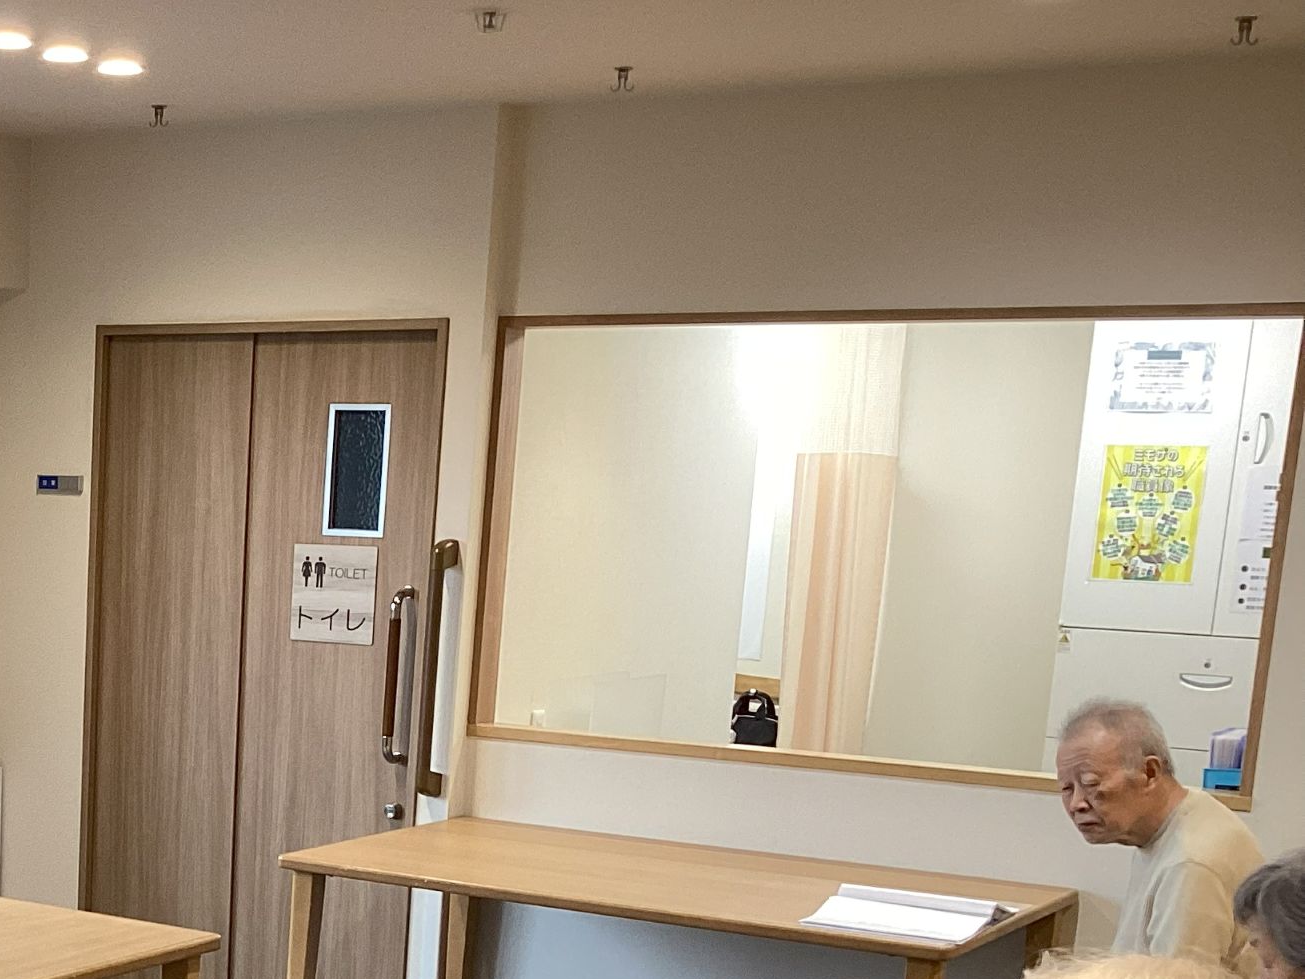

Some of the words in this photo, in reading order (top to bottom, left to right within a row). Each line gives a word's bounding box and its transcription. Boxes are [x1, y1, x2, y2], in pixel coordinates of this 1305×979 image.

[328, 567, 368, 580] TOILET
[298, 604, 366, 631] トイレ
